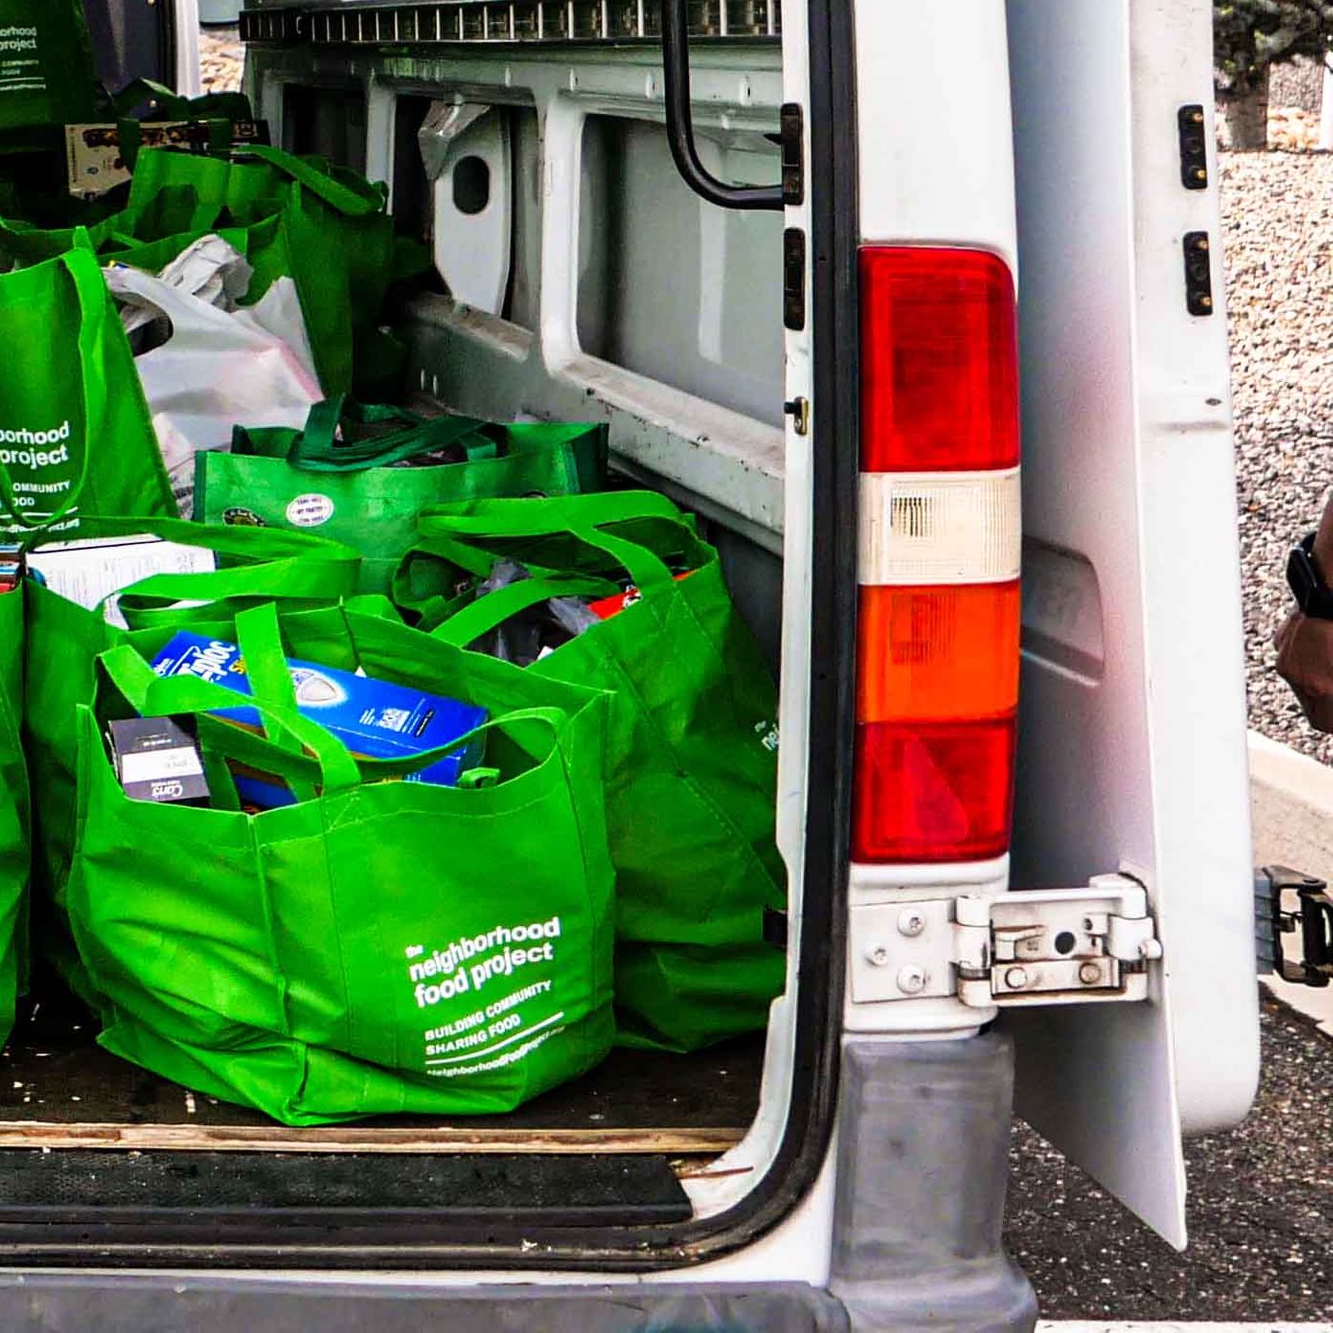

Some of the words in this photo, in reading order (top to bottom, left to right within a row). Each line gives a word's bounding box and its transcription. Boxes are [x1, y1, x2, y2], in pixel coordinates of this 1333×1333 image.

[405, 944, 424, 959] the
[410, 916, 561, 982] neighborhood
[415, 967, 469, 1008] food
[470, 941, 554, 990] project
[425, 1011, 484, 1041] BUILDING
[486, 979, 552, 1017] COMMUNITY
[426, 1030, 487, 1055] SHARING
[488, 1013, 522, 1038] FOOD
